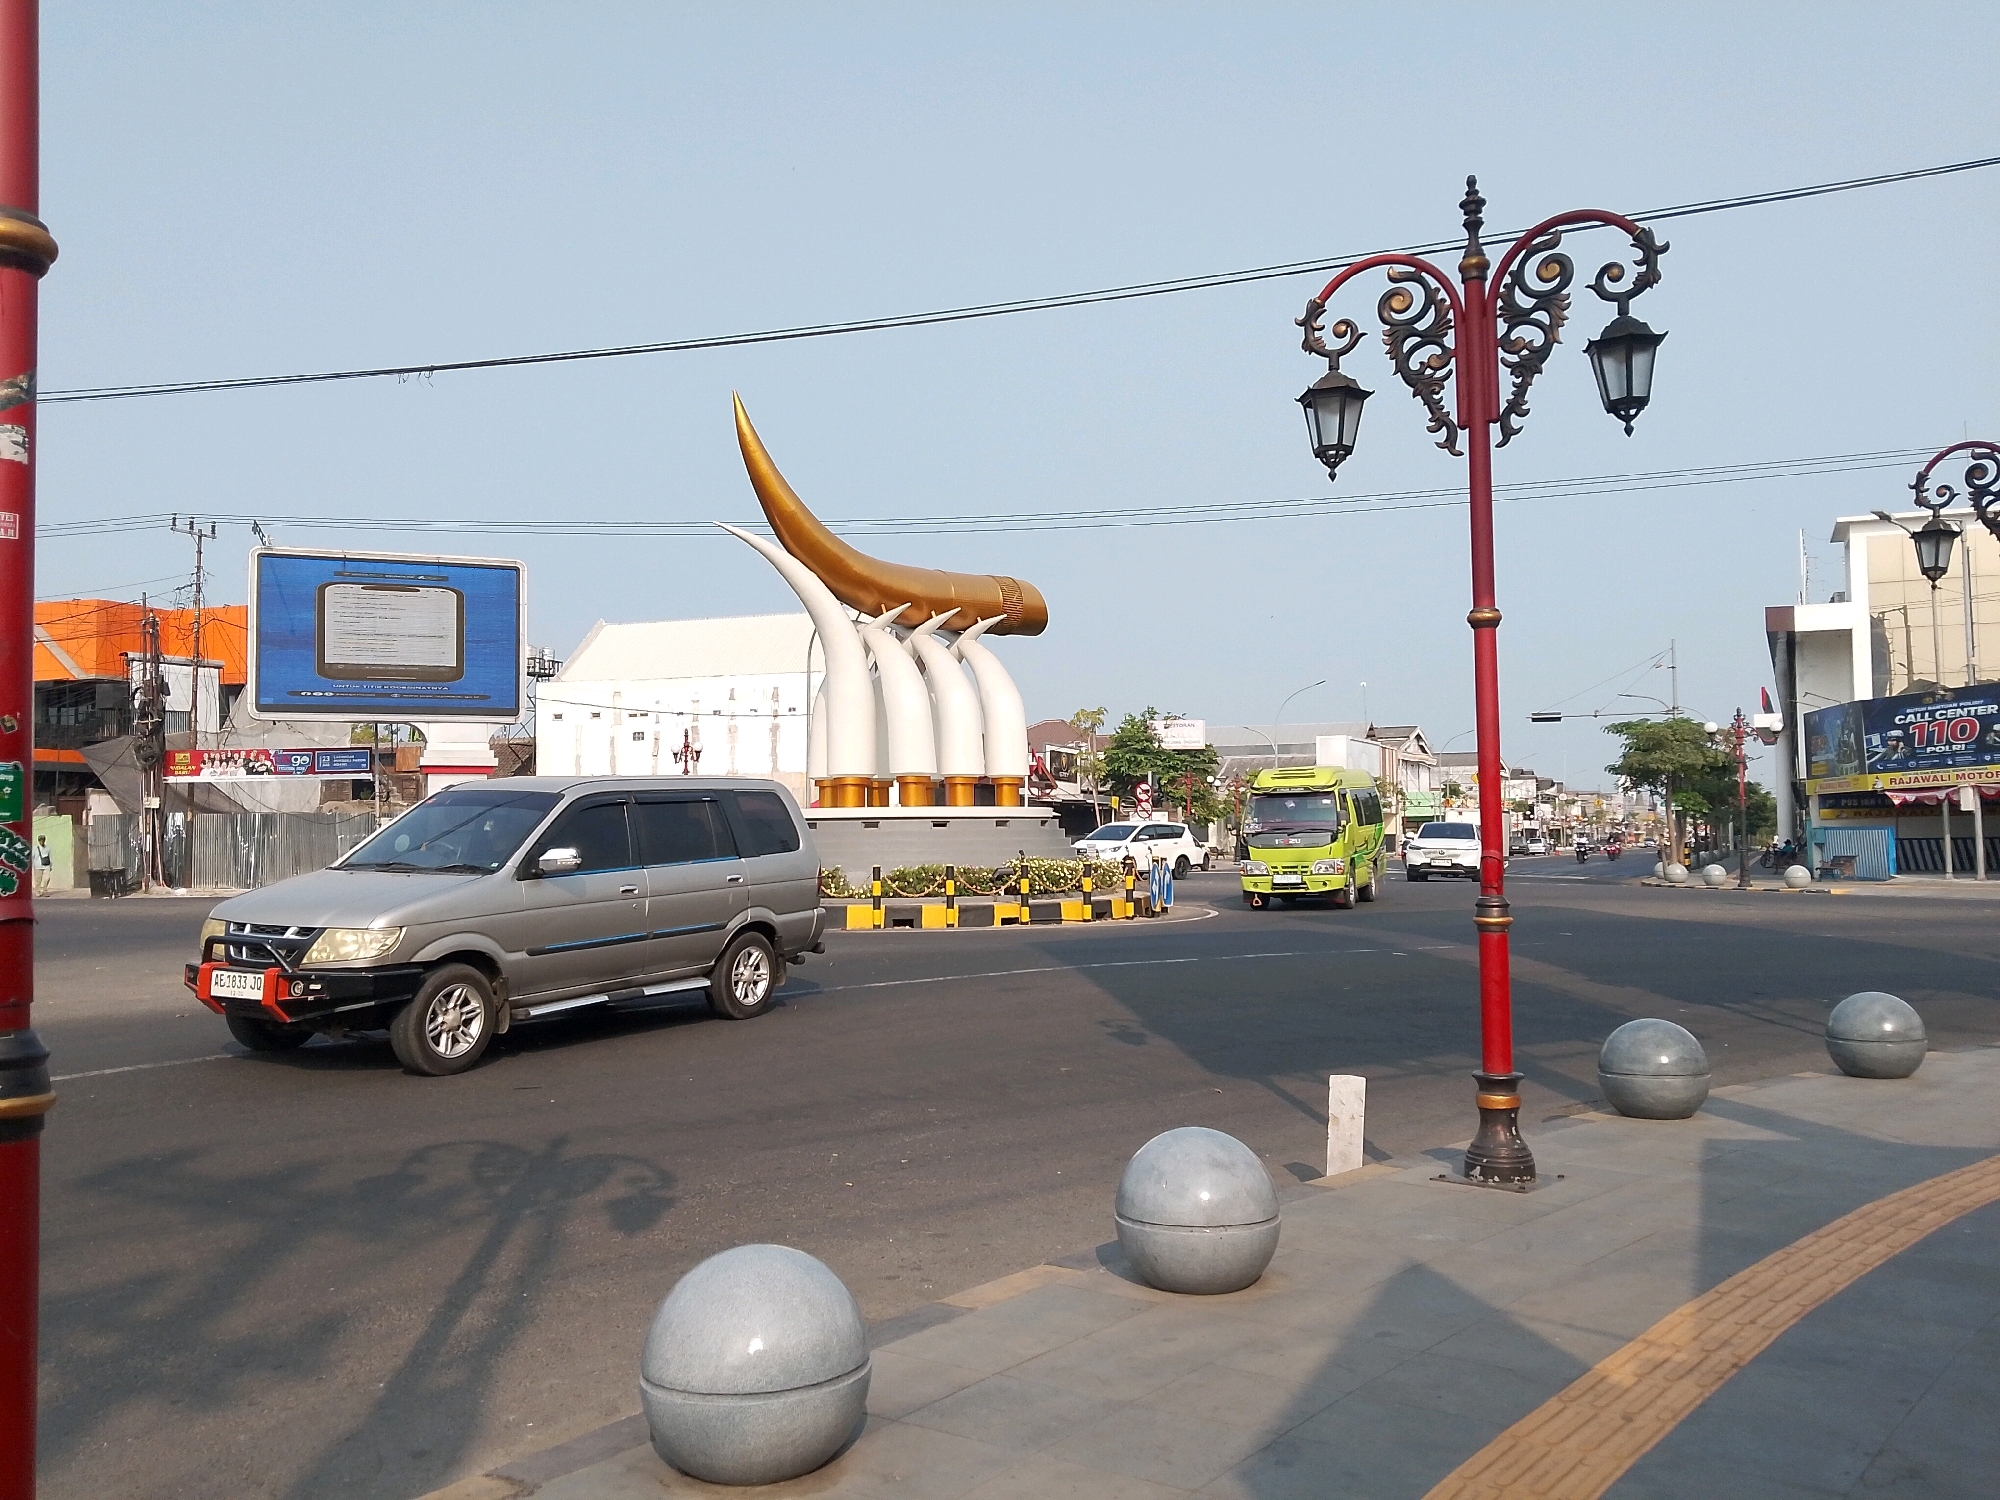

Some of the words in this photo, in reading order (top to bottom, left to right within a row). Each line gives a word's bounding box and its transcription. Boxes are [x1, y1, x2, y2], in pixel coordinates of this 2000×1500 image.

[1894, 712, 1933, 725] CALL
[1935, 704, 1999, 720] CENTER
[1909, 717, 1980, 747] 110
[1926, 744, 1966, 753] POLRI
[1889, 774, 1951, 786] RAJAWALI
[214, 973, 225, 987] AE
[226, 974, 247, 989] 1833
